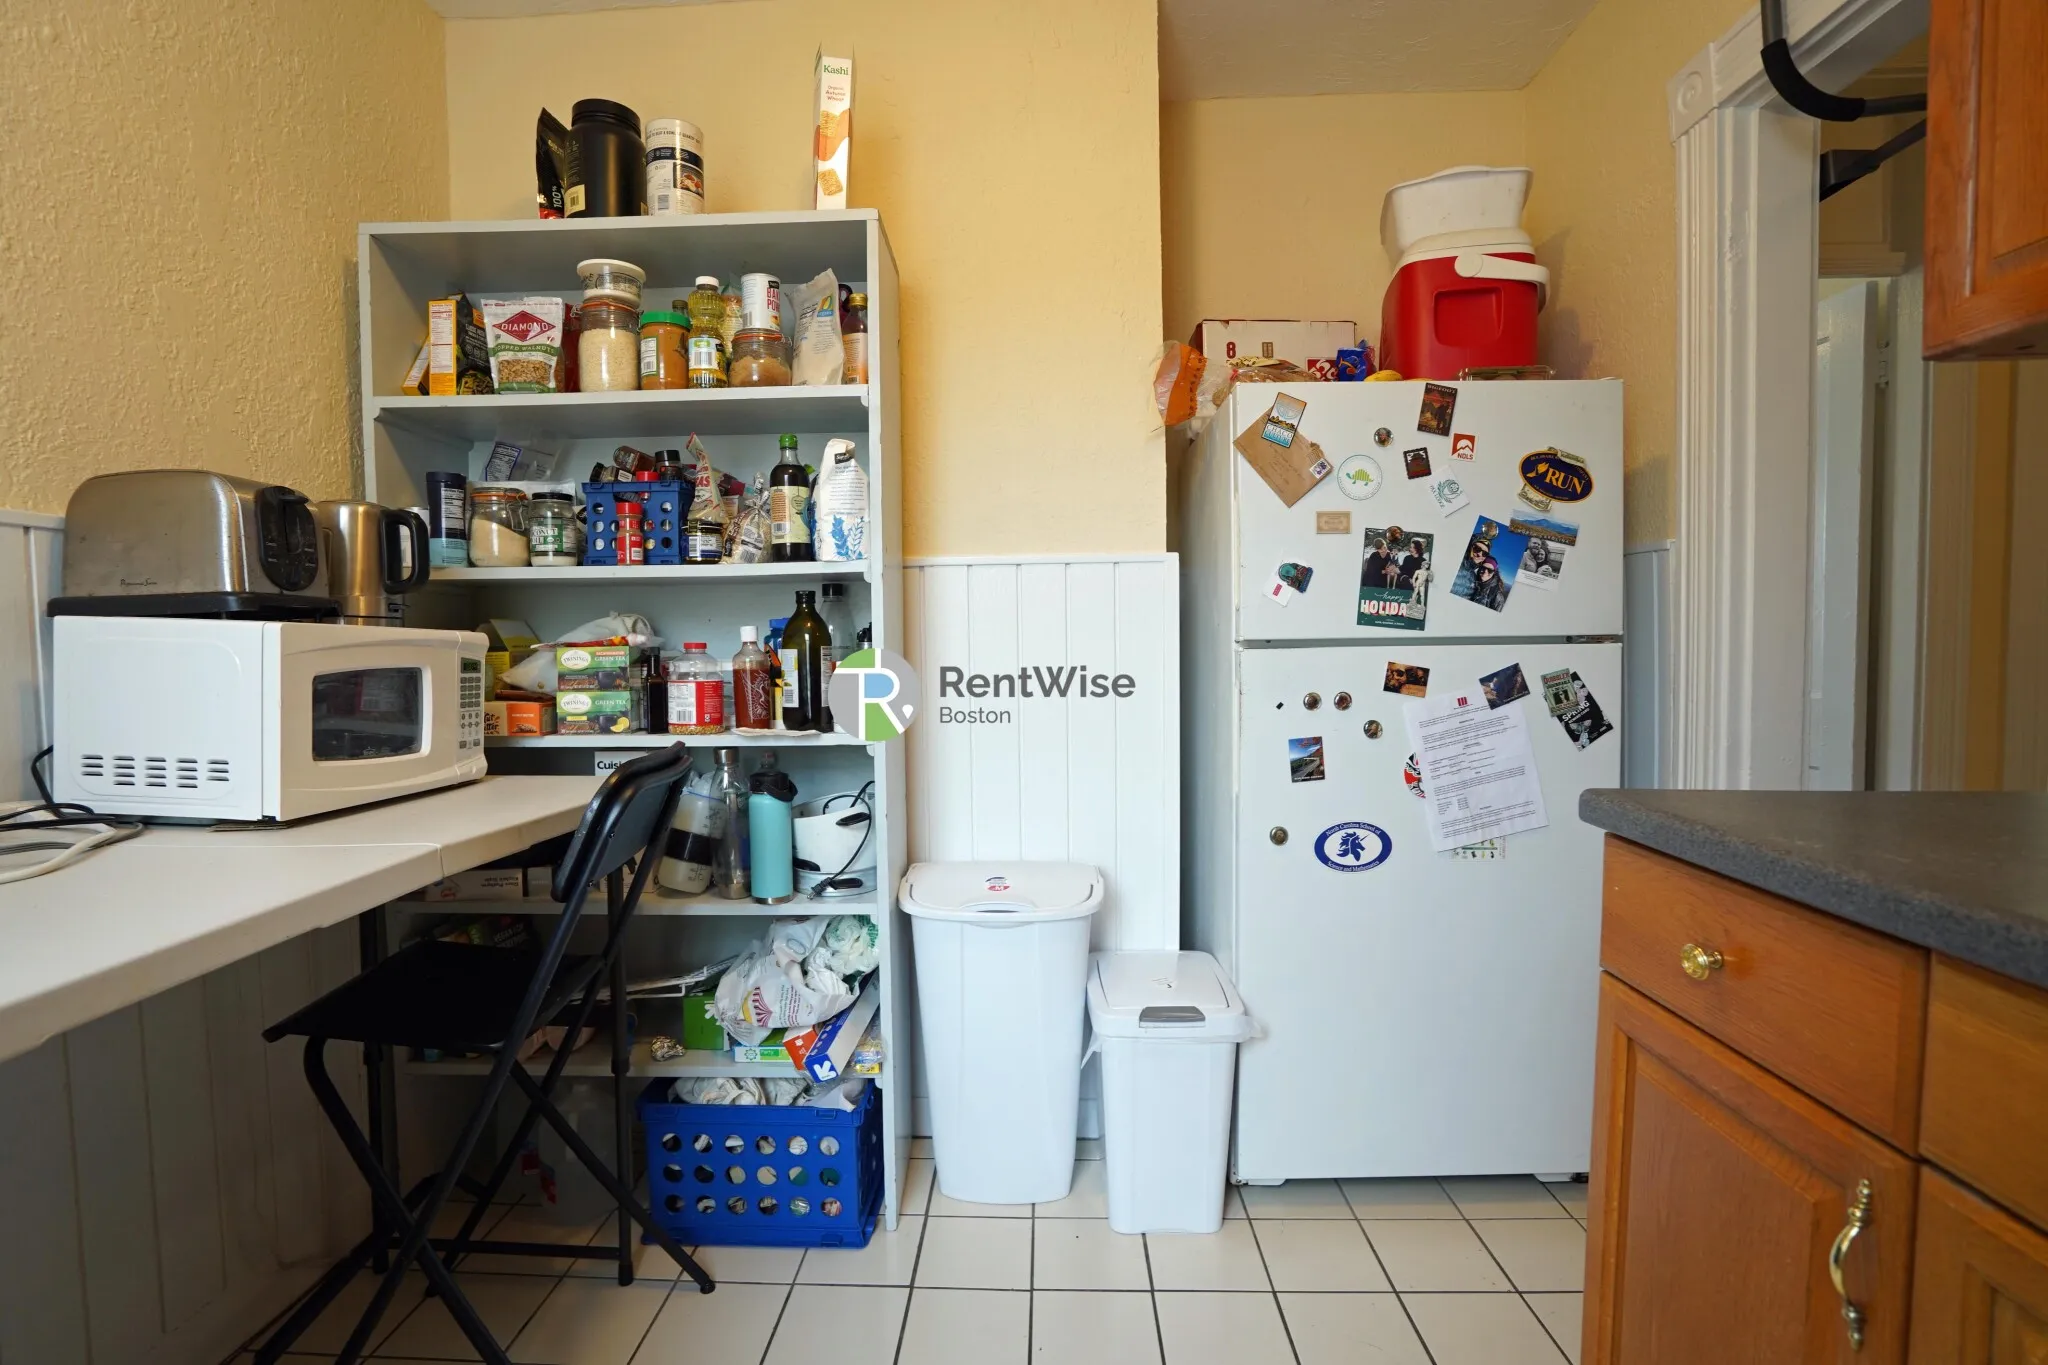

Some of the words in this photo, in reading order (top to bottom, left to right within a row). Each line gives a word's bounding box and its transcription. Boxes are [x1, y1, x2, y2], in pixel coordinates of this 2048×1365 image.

[823, 64, 849, 75] Kashi
[552, 185, 563, 208] 100%
[501, 322, 549, 331] DIAMOND
[521, 345, 554, 354] WALNUTS
[1226, 341, 1236, 359] 8
[1267, 423, 1293, 439] CHACO
[1544, 467, 1585, 495] RUN
[1376, 591, 1404, 602] happy
[1360, 600, 1407, 616] HOLIDA
[563, 655, 589, 663] TWININGS
[563, 699, 589, 707] TWININGS
[596, 760, 621, 770] Cuisi
[1325, 826, 1340, 837] North
[1360, 823, 1376, 832] School
[1328, 860, 1343, 871] Science
[1352, 860, 1380, 872] Mathematics
